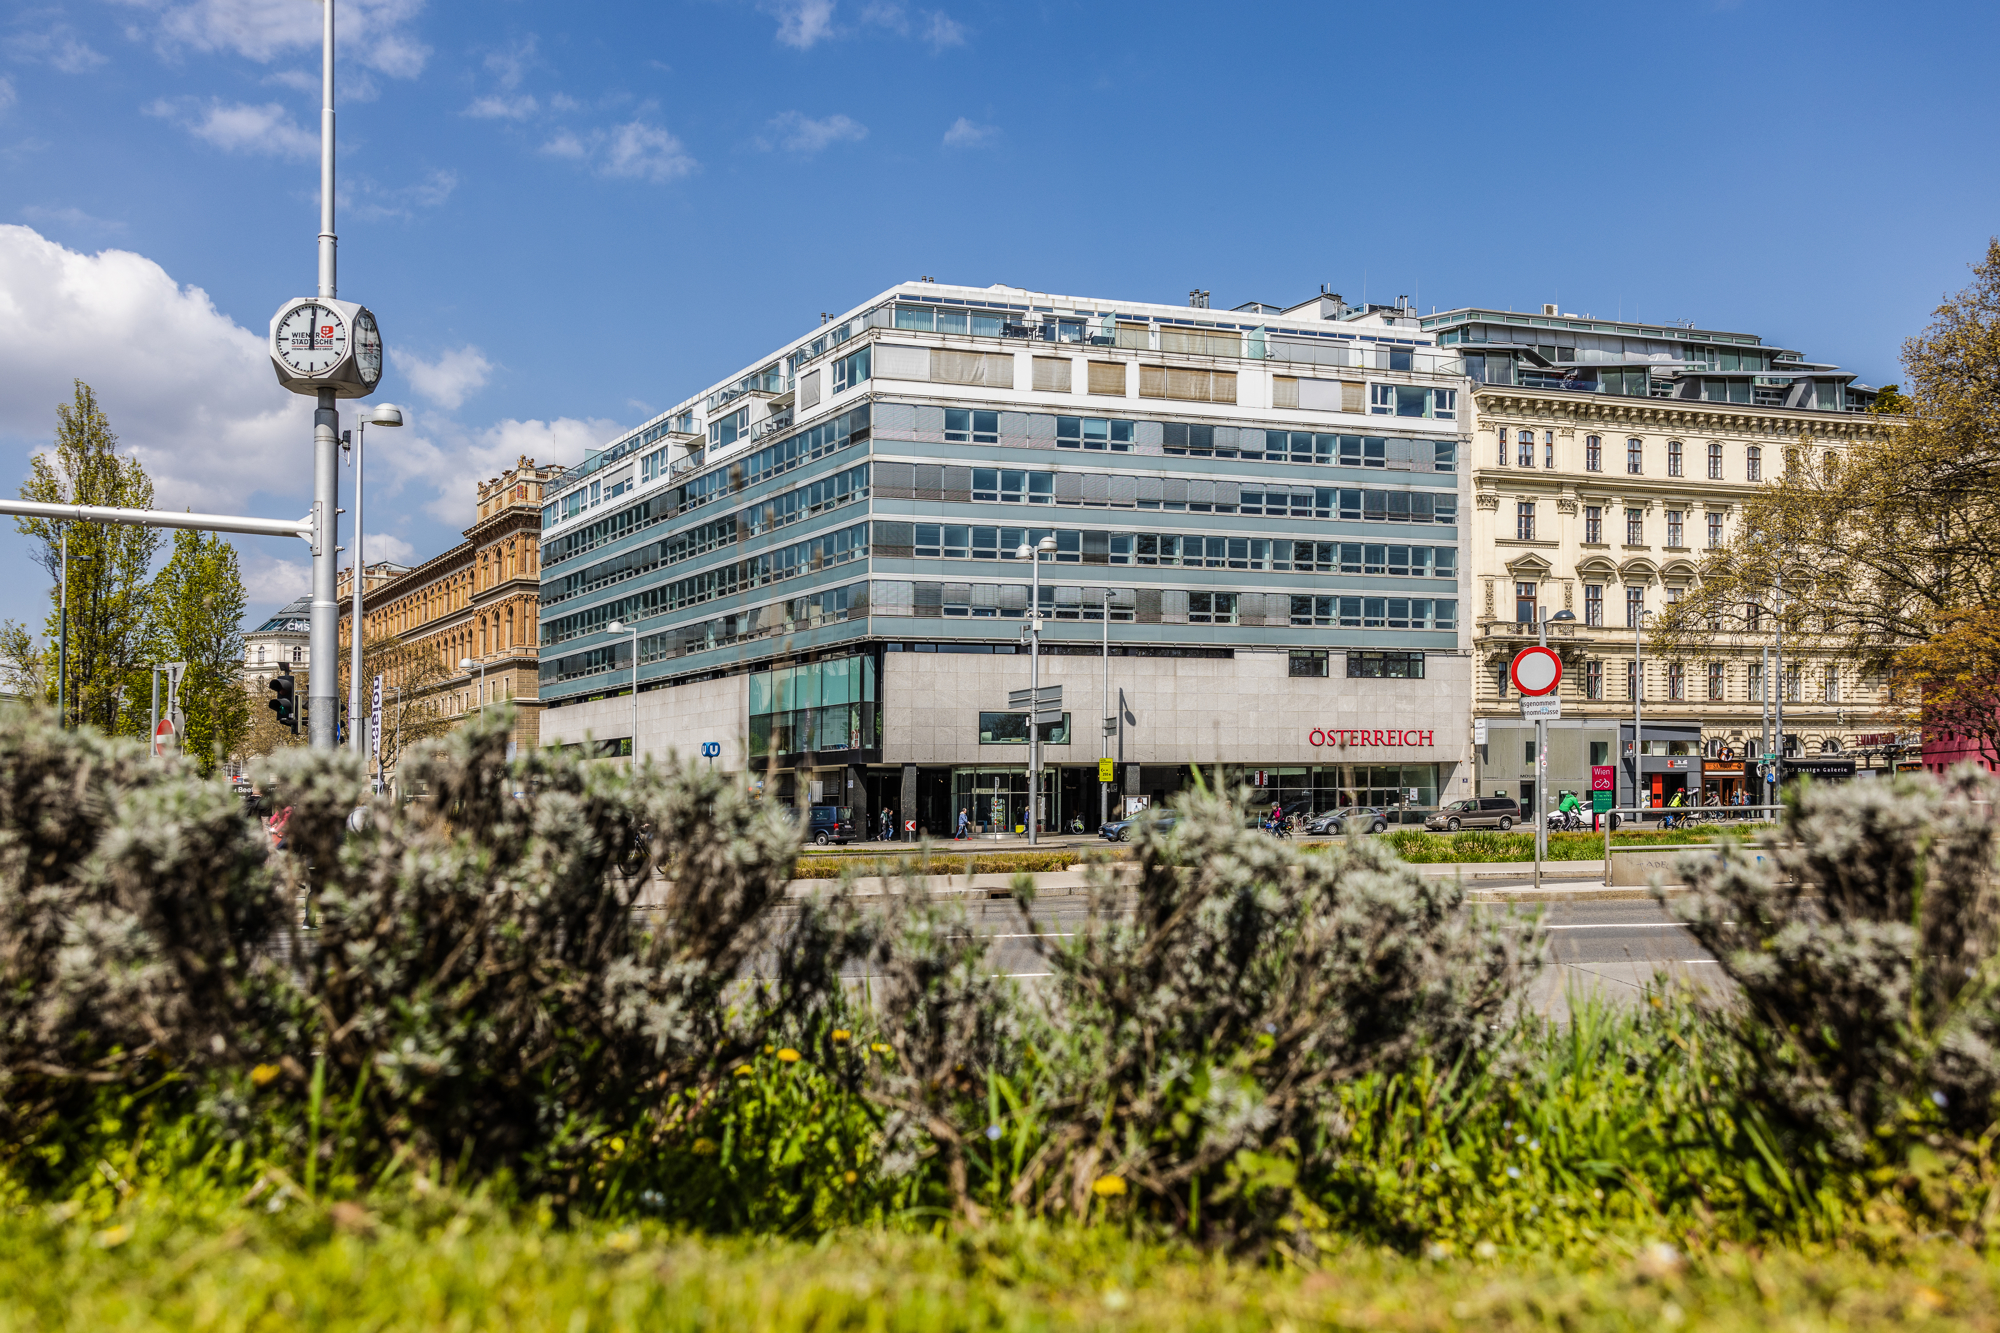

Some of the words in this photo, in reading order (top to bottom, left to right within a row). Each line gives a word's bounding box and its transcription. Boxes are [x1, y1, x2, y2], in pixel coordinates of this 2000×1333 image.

[287, 622, 310, 631] CMS
[1308, 727, 1434, 747] ÖSTERREICH
[710, 745, 718, 755] U
